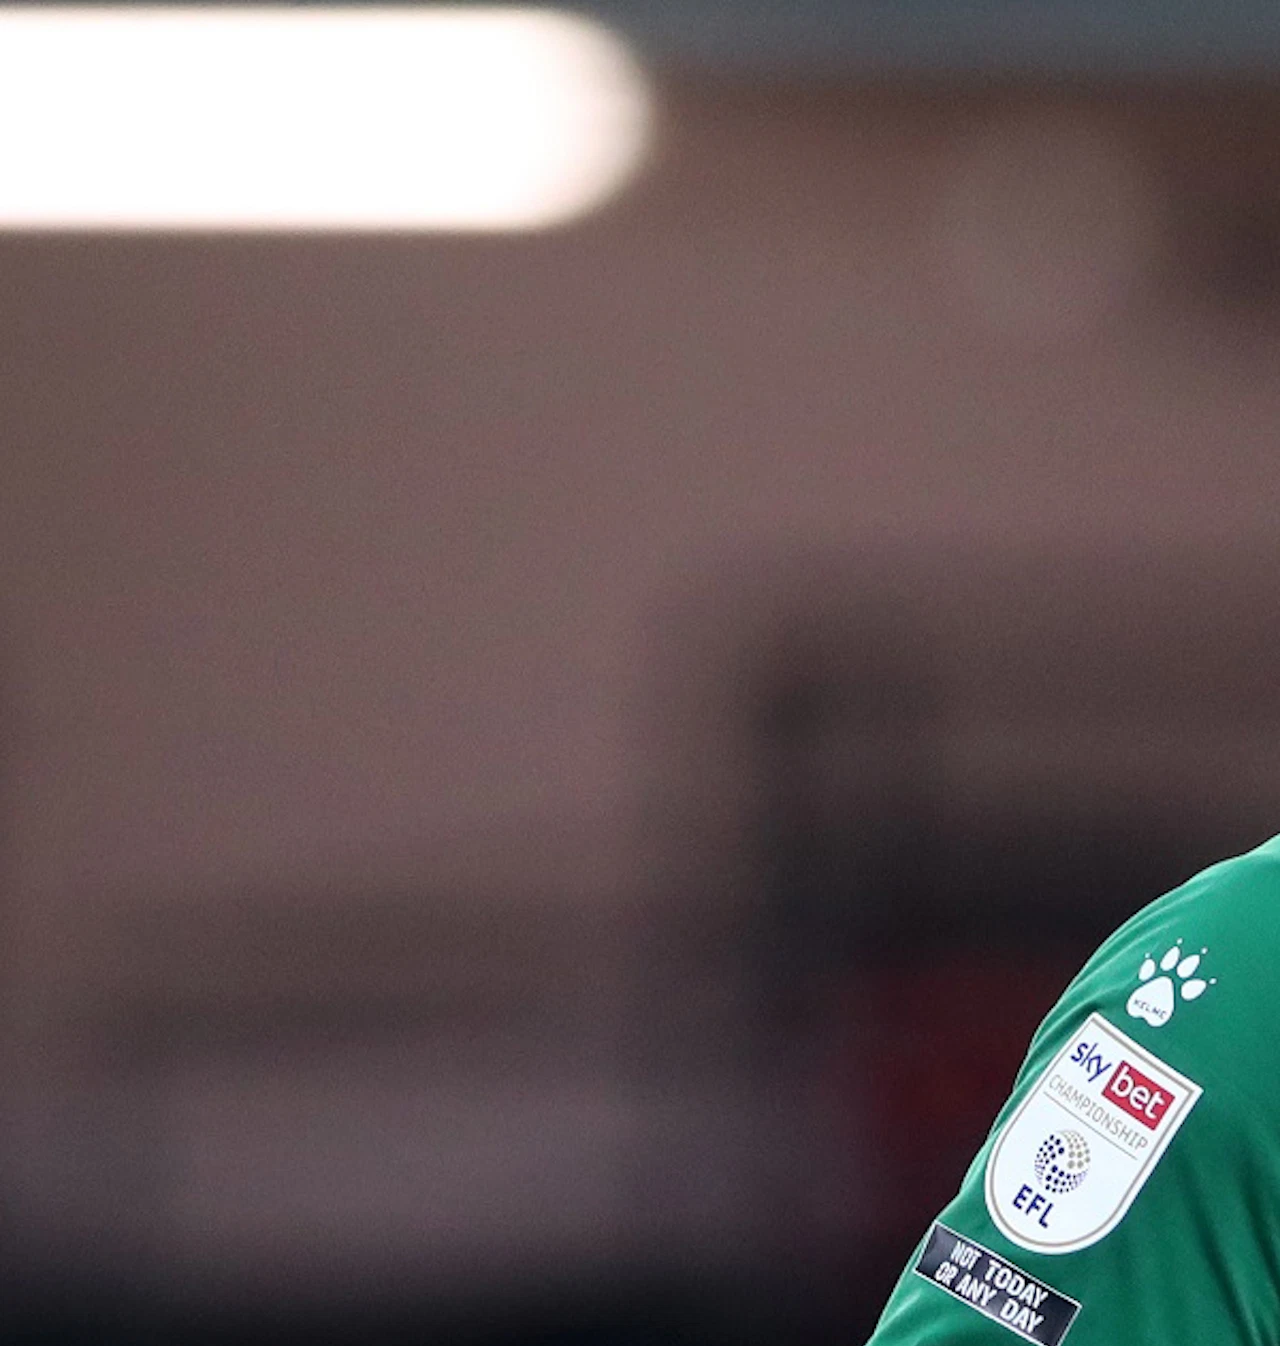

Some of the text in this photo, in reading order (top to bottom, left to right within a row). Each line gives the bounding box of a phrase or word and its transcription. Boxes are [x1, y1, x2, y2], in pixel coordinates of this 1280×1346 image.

[1048, 1074, 1149, 1150] CHAMPIONSHIP
[1070, 1042, 1166, 1120] sky bet
[1011, 1184, 1052, 1229] EFL
[934, 1260, 1044, 1334] OR ANY DAY
[950, 1240, 1049, 1309] NOT TODAY
